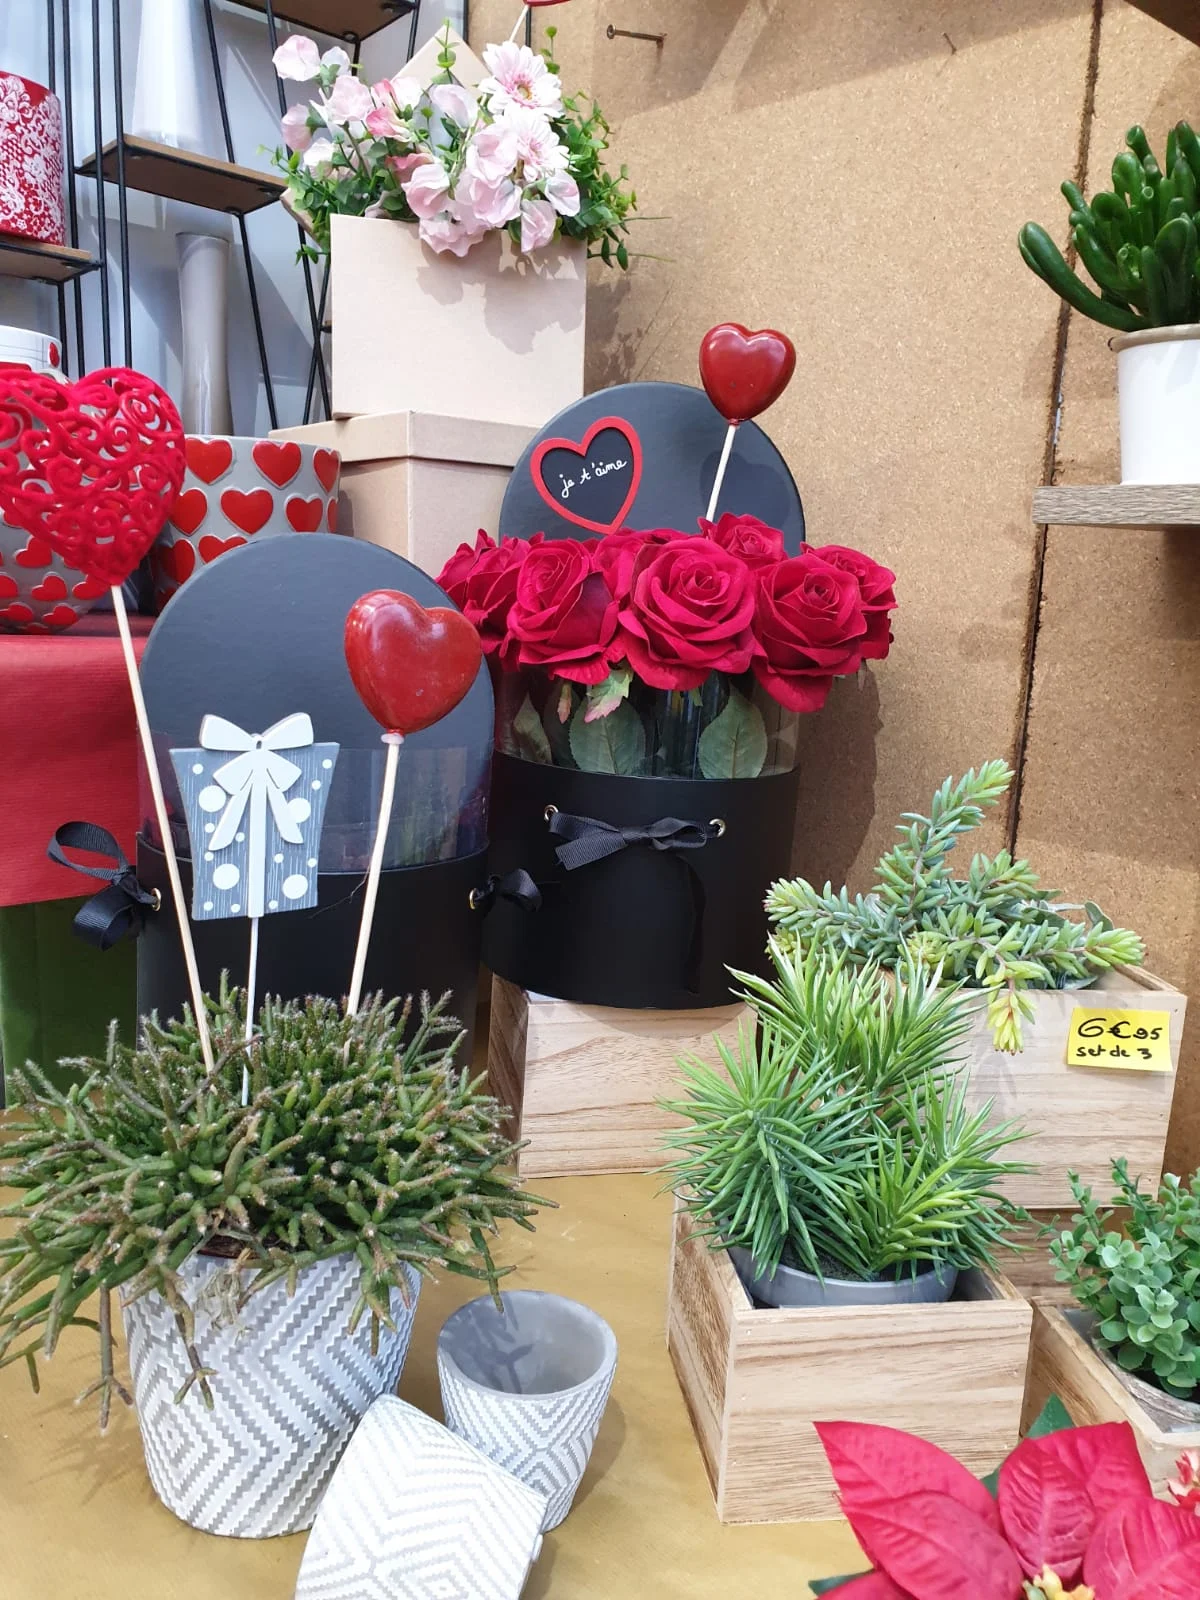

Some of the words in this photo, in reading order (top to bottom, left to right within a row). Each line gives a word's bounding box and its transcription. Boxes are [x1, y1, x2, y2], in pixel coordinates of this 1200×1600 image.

[559, 474, 575, 498] je
[580, 460, 628, 485] t'aime
[1076, 1044, 1106, 1057] set
[1109, 1045, 1131, 1057] de
[1137, 1048, 1153, 1060] 3
